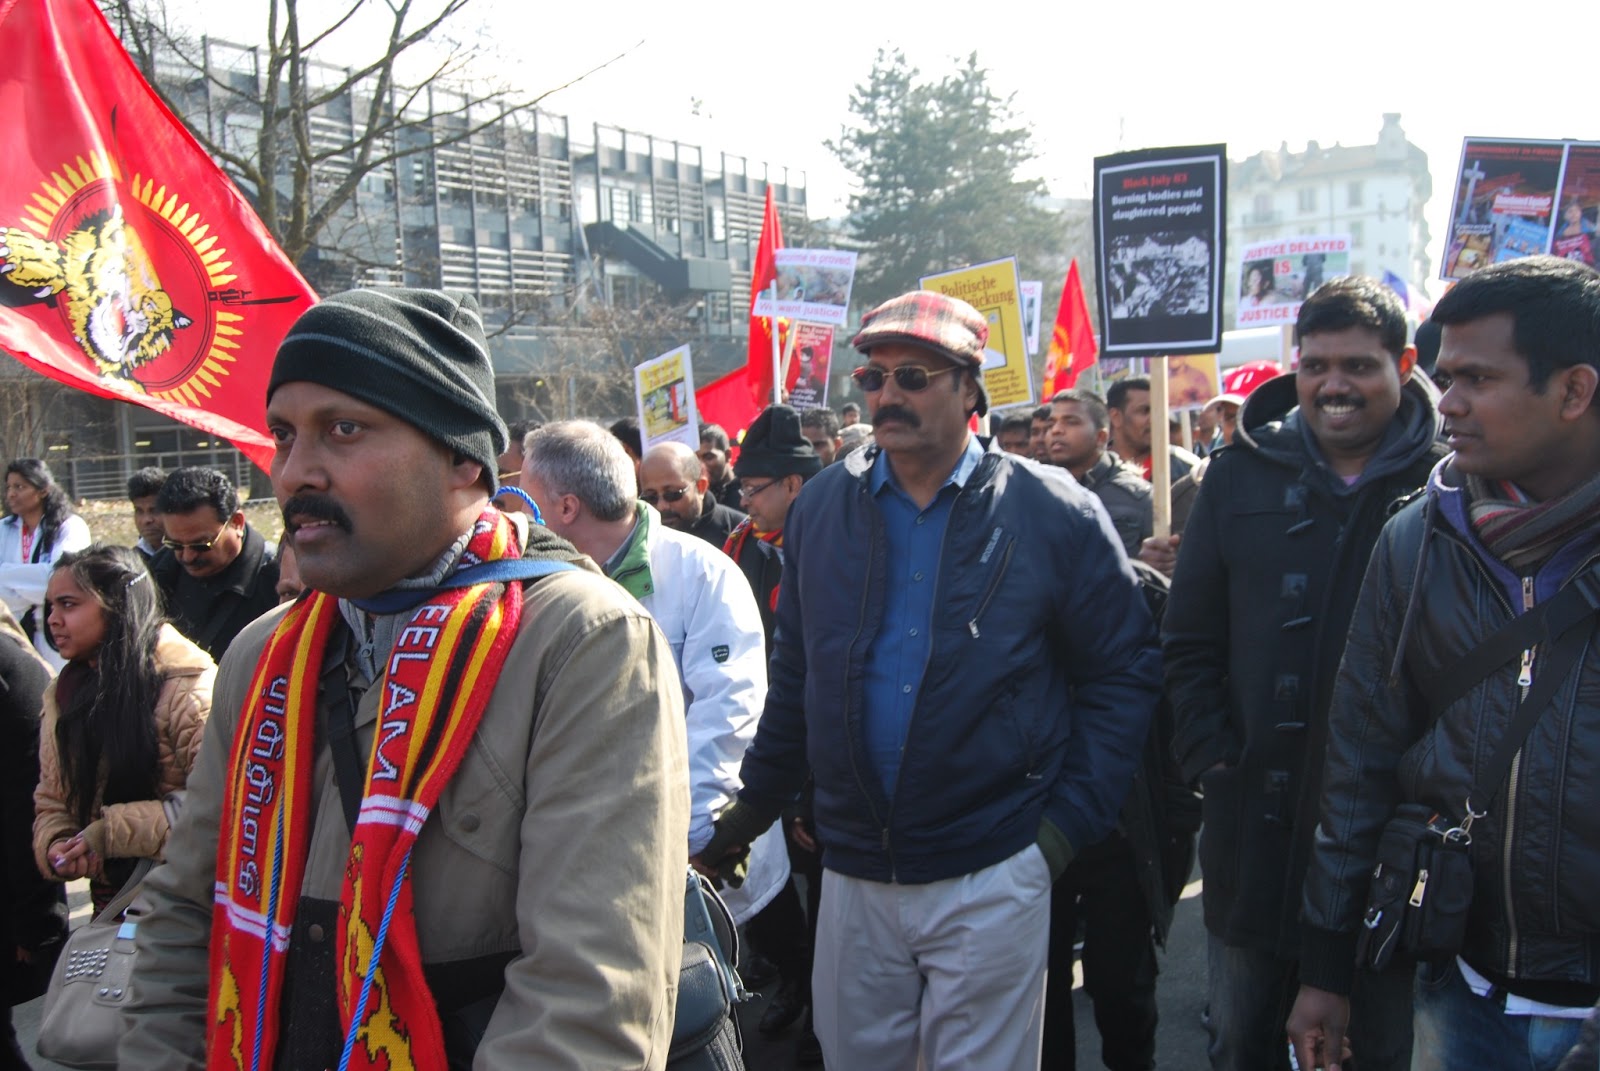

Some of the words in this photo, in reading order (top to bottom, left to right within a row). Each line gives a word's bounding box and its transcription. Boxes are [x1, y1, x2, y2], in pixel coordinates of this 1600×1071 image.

[1123, 177, 1149, 189] Black
[1150, 174, 1172, 188] July
[1111, 192, 1147, 206] Burning
[1147, 188, 1182, 202] bodies
[1182, 186, 1203, 199] and
[1112, 205, 1166, 221] slaughtered
[1167, 203, 1203, 217] people
[1244, 244, 1286, 259] JUSTICE
[1289, 240, 1346, 254] DELAYED
[1274, 260, 1292, 276] IS
[941, 276, 996, 295] Politische
[778, 303, 801, 313] want
[1240, 306, 1289, 322] JUSTICE
[372, 604, 453, 781] EELAM
